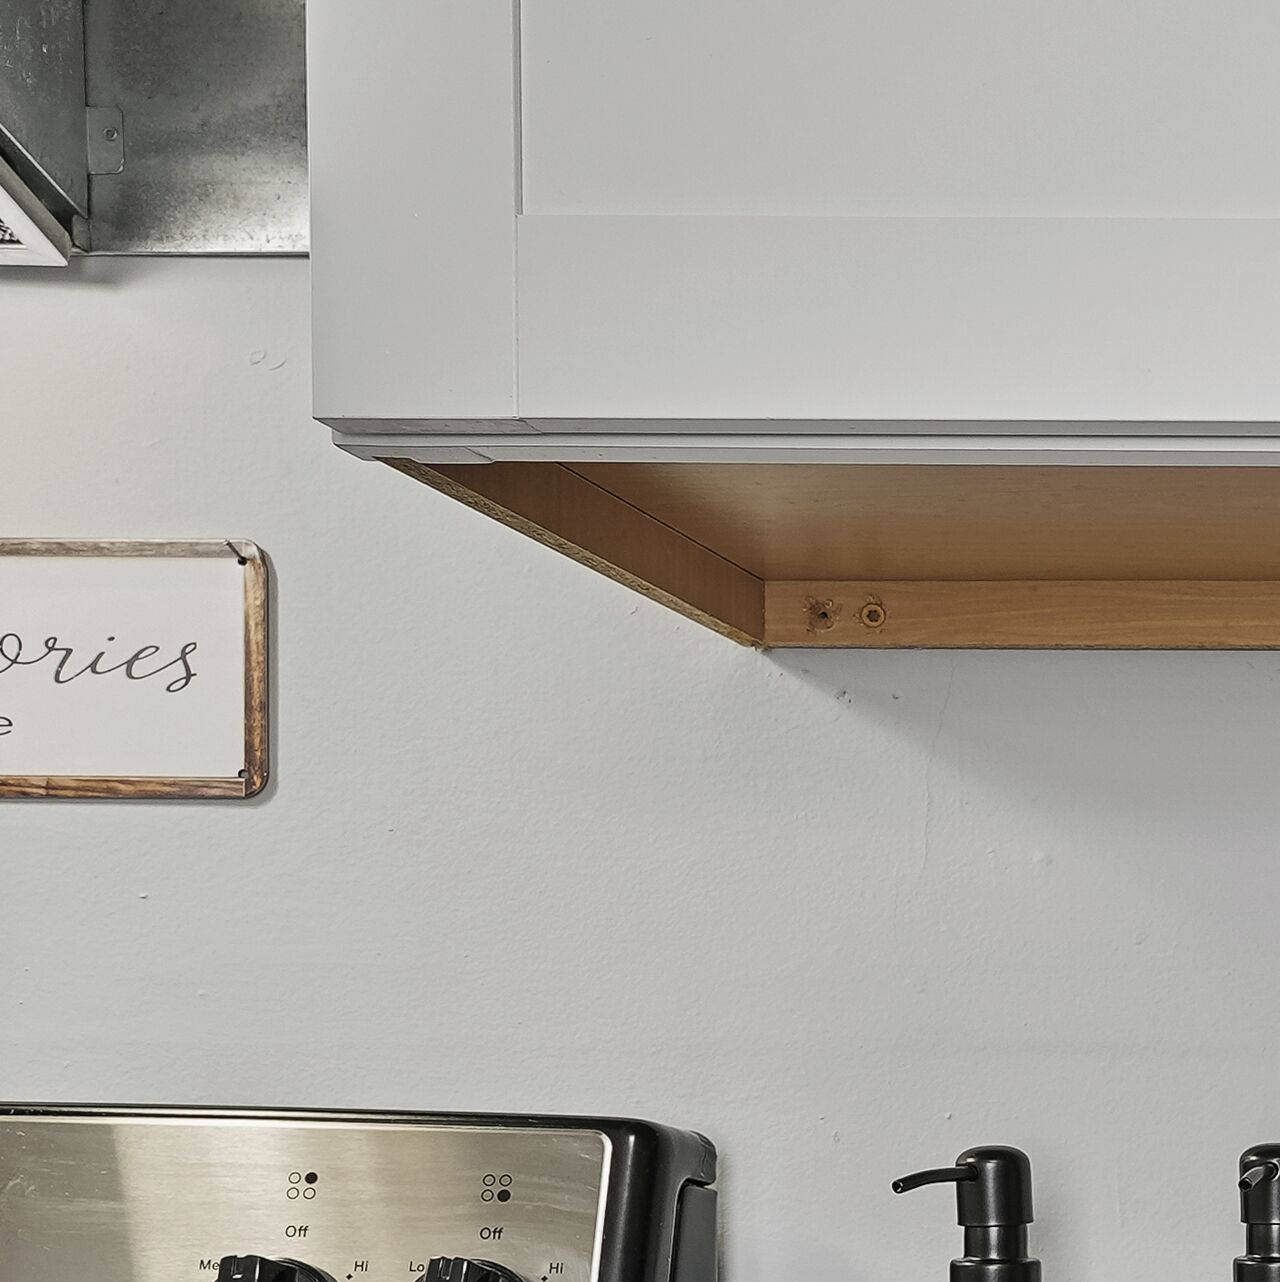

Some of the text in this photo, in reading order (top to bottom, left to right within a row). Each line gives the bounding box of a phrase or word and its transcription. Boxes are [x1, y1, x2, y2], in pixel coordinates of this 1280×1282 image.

[285, 1225, 309, 1239] Off
[480, 1227, 503, 1241] Off
[354, 1261, 369, 1272] Hi
[409, 1261, 425, 1272] Lo
[549, 1262, 564, 1274] Hi
